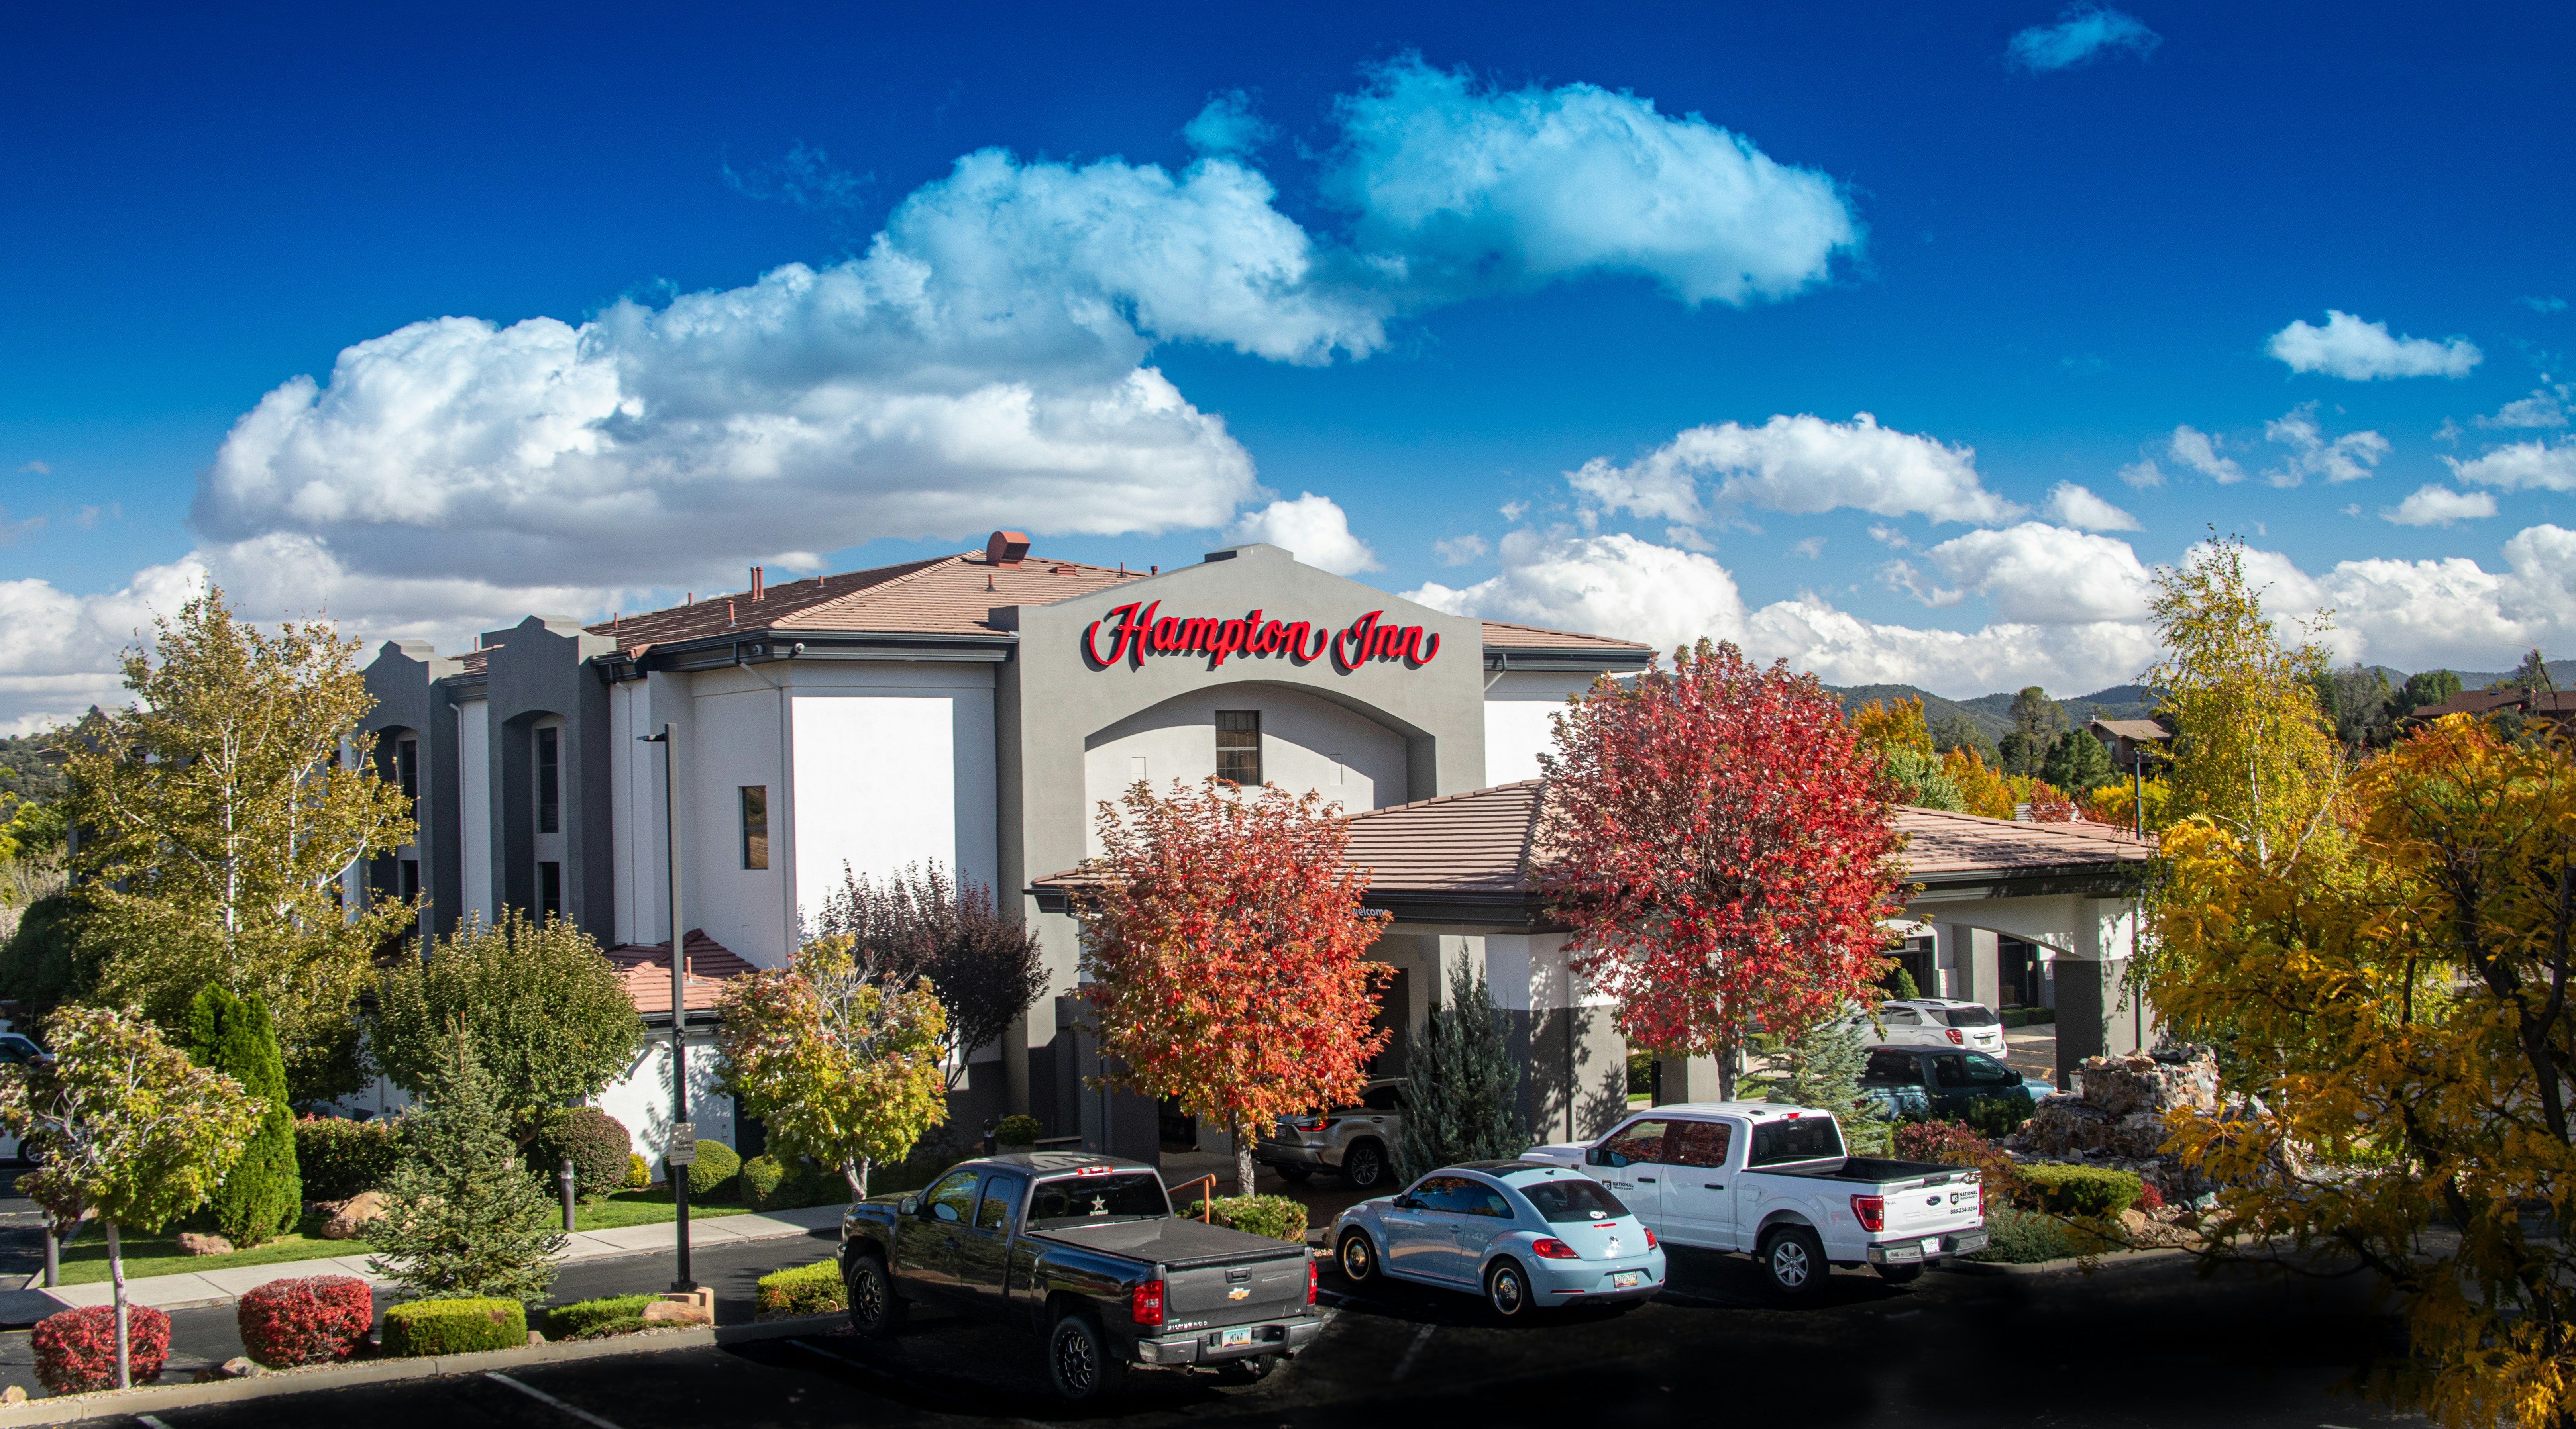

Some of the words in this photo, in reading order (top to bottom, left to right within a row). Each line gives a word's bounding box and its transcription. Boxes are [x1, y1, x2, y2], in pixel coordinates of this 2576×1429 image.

[1088, 599, 1328, 666] Hampton
[1339, 610, 1439, 670] Inn
[1950, 1206, 1977, 1215] 888-234-9244
[1617, 1273, 1636, 1283] BZP6375
[1230, 1333, 1243, 1342] MOWA
